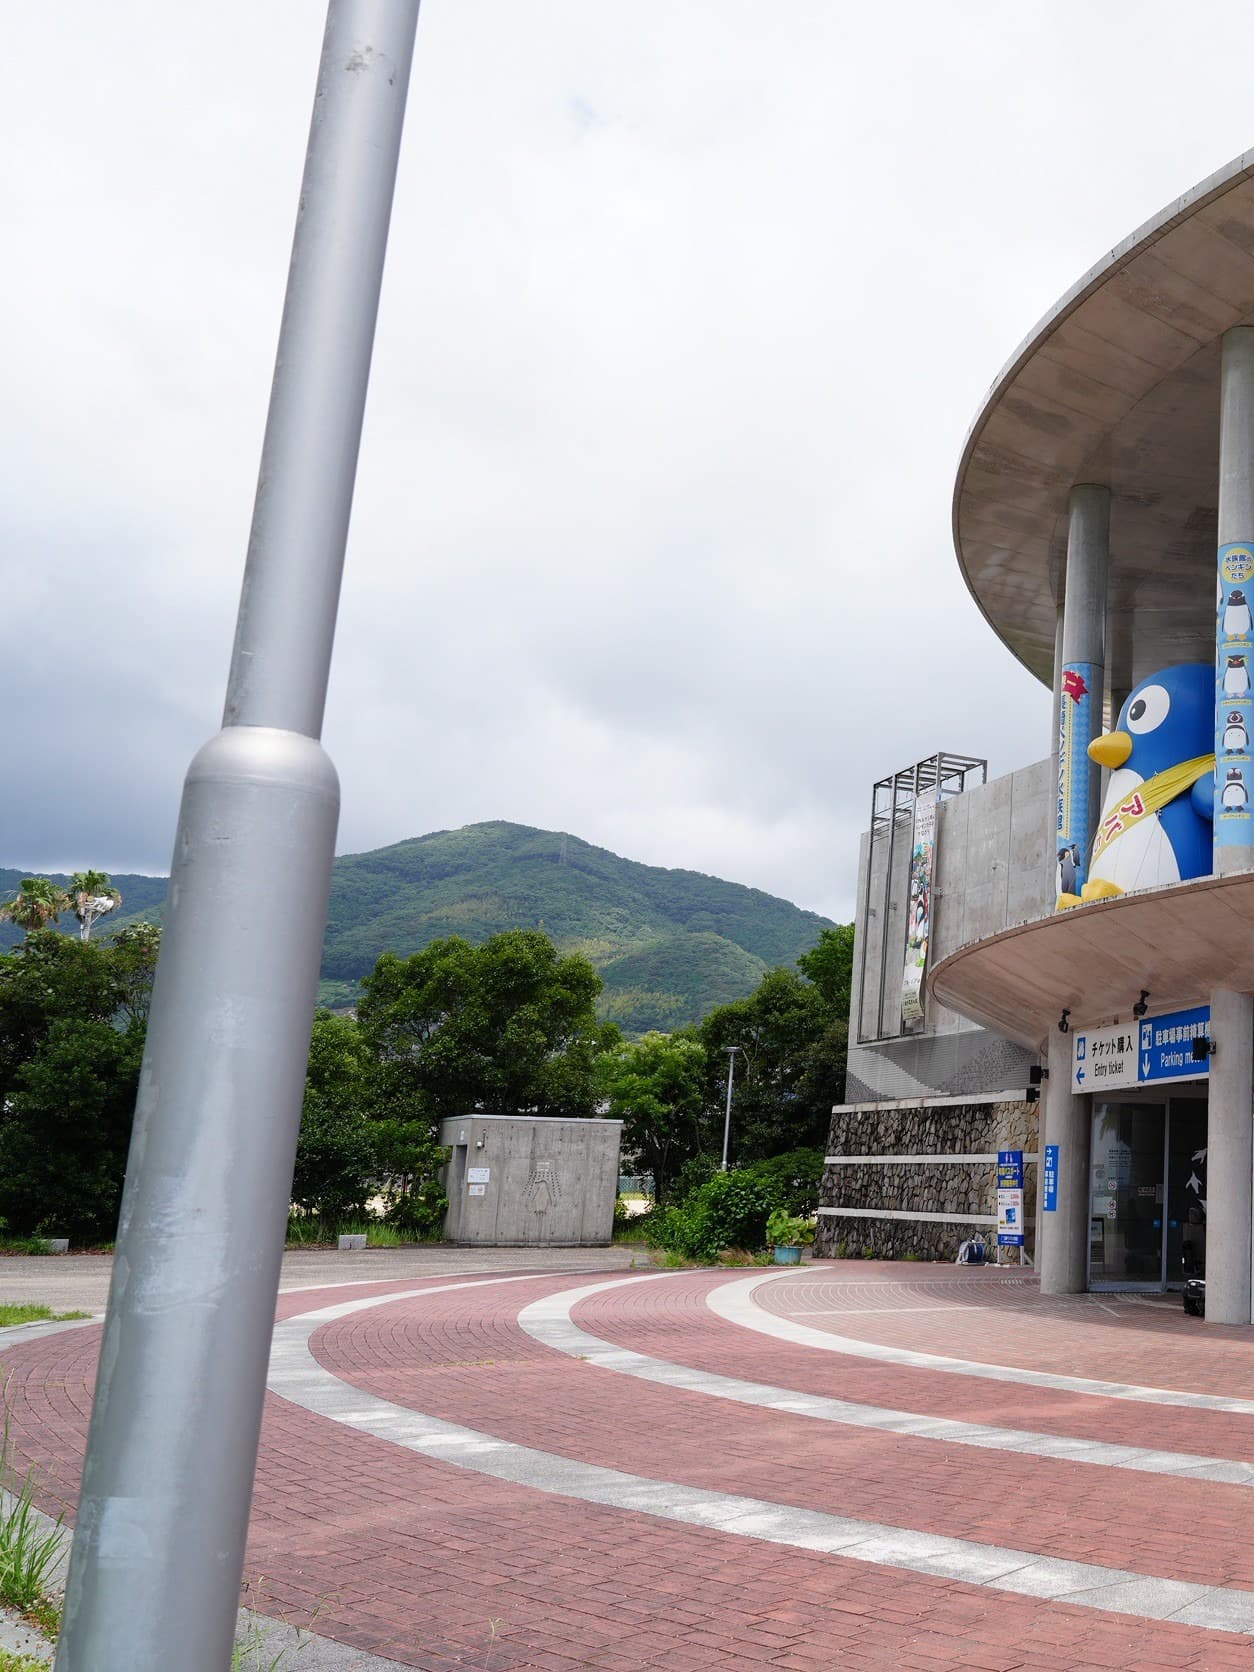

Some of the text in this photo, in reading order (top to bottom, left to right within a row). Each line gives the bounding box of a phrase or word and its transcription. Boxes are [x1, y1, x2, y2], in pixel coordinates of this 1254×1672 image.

[1091, 1035, 1133, 1057] チケット購入
[1094, 1060, 1124, 1077] Entry ticket
[1160, 1052, 1184, 1068] Parking
